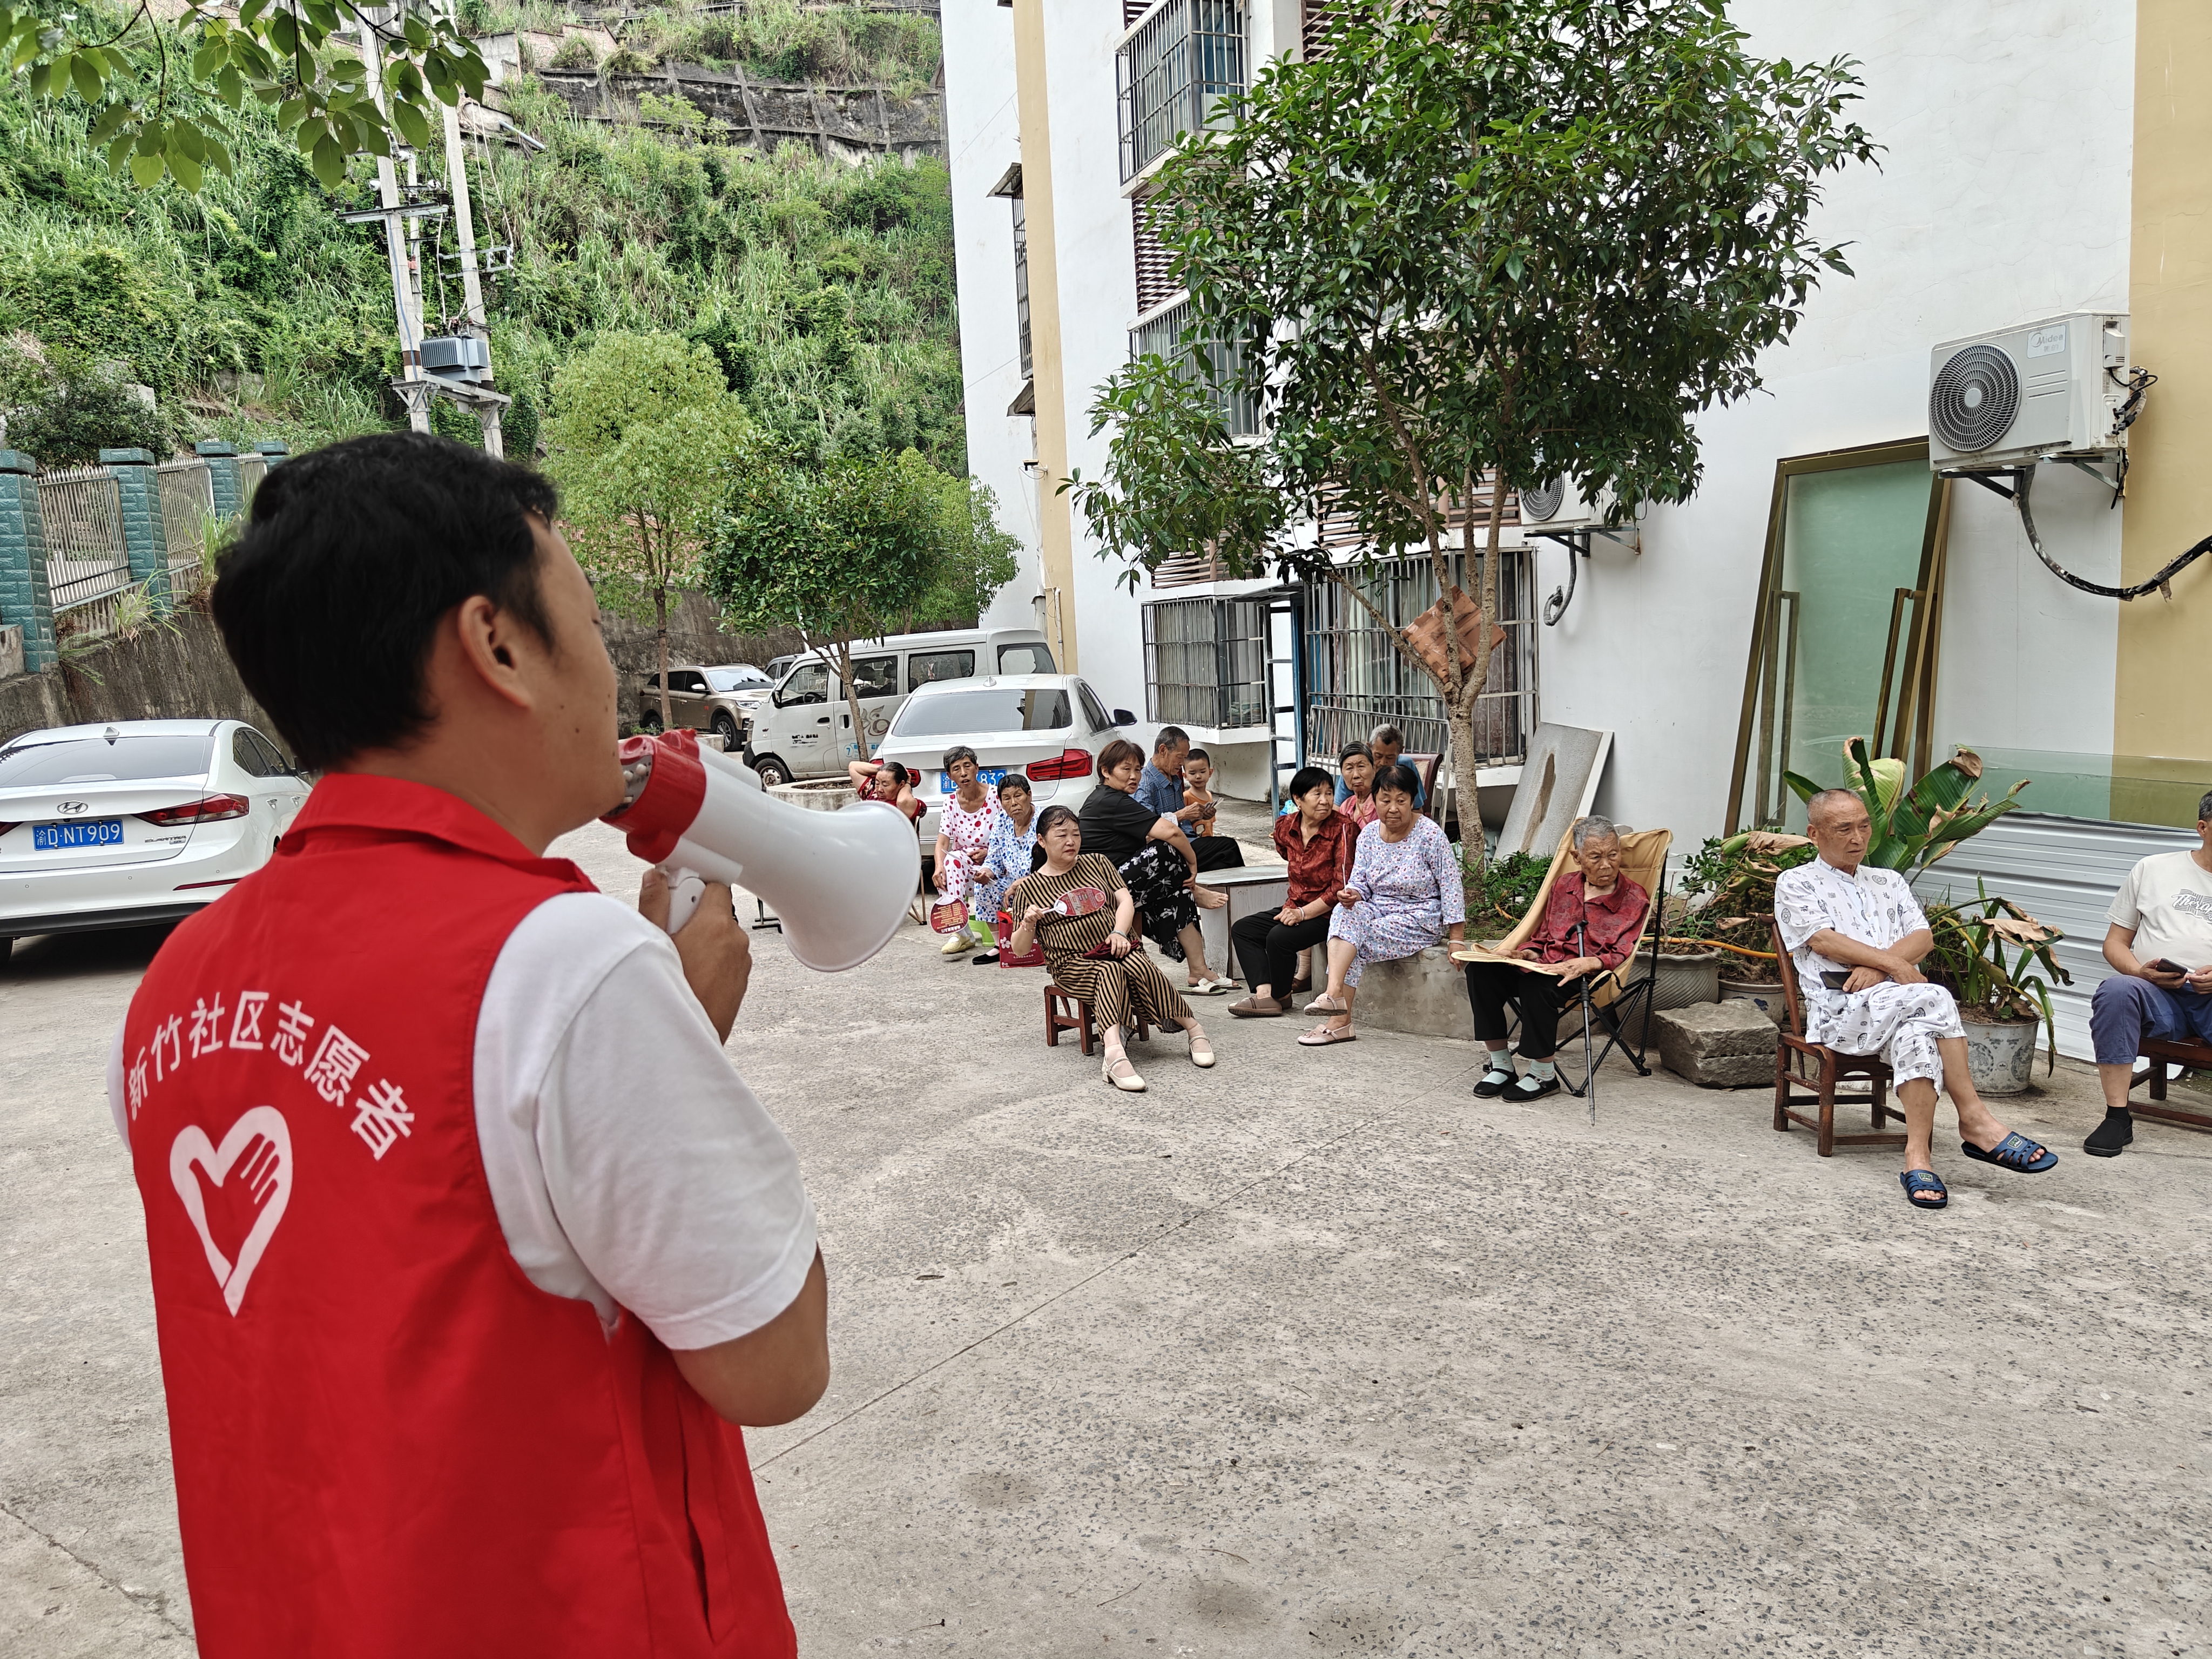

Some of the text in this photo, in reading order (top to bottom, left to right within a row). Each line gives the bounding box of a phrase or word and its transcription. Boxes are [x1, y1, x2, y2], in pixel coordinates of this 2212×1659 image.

[2035, 334, 2063, 345] Midea
[129, 990, 415, 1161] 新竹社区志愿者
